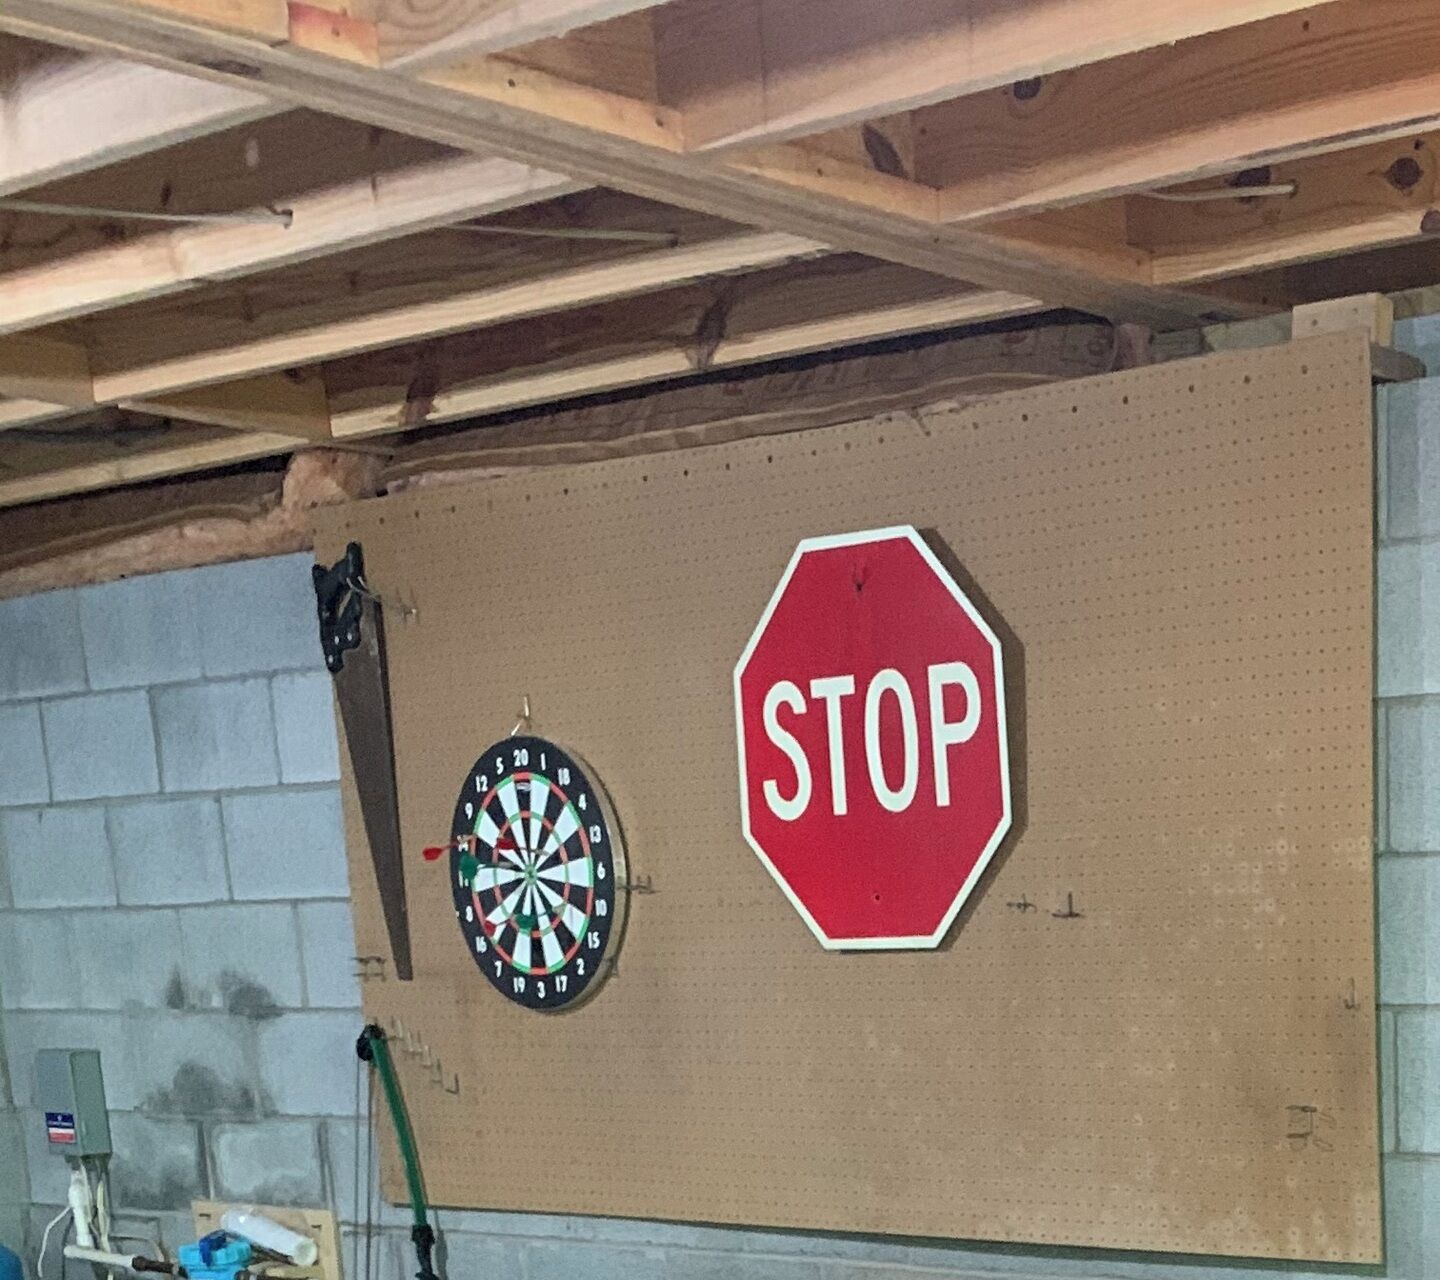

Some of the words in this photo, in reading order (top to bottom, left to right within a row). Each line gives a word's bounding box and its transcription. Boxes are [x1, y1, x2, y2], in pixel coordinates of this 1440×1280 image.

[762, 661, 982, 821] STOP
[496, 757, 504, 775] 5
[513, 748, 529, 767] 20
[540, 753, 547, 771] 1
[476, 775, 488, 792] 12
[578, 793, 587, 811] 4
[465, 803, 473, 820] 9
[589, 825, 601, 843] 13
[597, 862, 606, 880] 6
[465, 905, 473, 922] 8
[595, 899, 607, 917] 10
[476, 936, 487, 953] 16
[588, 931, 600, 949] 15
[494, 960, 503, 978] 7
[576, 958, 585, 975] 2
[513, 976, 526, 993] 19
[537, 981, 546, 999] 3
[555, 975, 568, 992] 17
